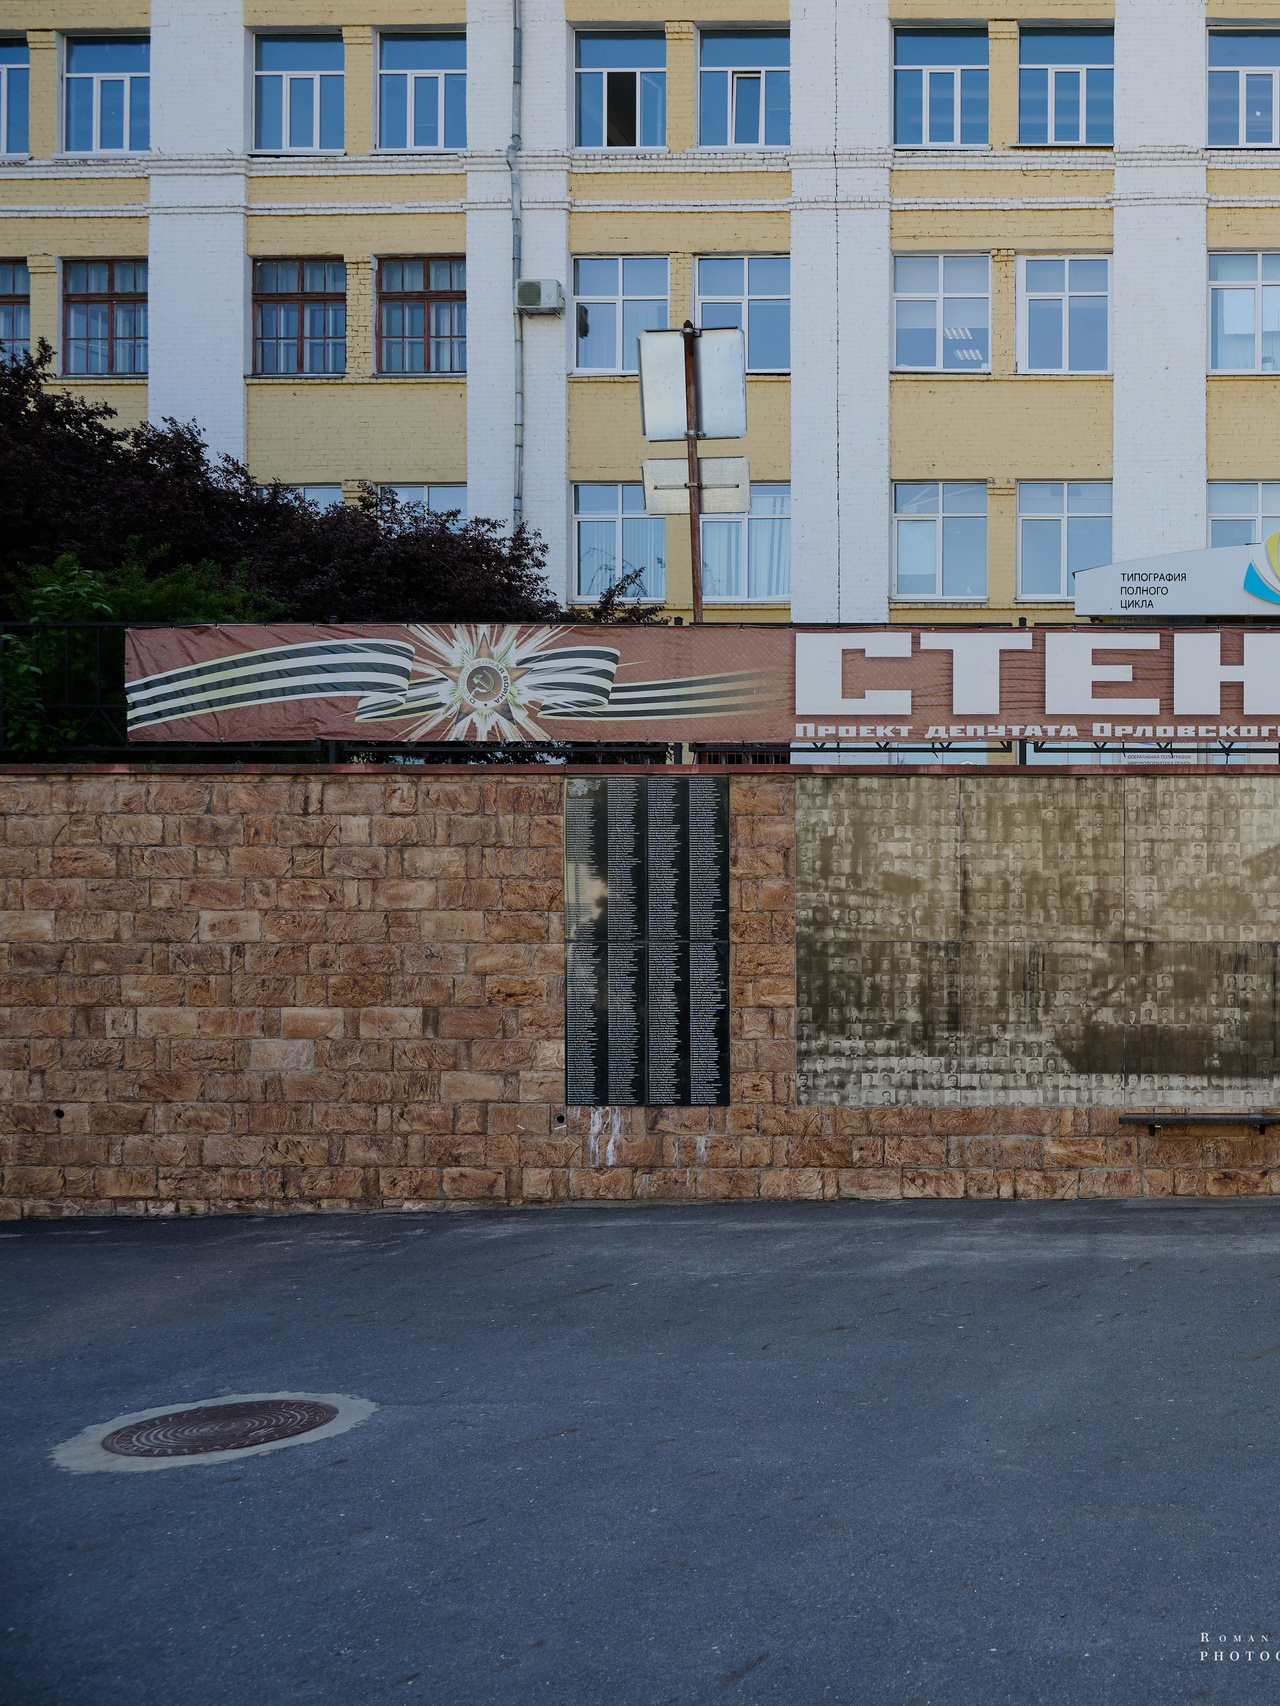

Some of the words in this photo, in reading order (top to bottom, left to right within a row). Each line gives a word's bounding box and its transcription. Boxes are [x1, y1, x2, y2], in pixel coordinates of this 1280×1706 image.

[1120, 572, 1187, 582] ТИПОГРАФИЯ
[1120, 586, 1169, 595] ПОЛНОГО
[1120, 599, 1155, 610] ЦИКЛА
